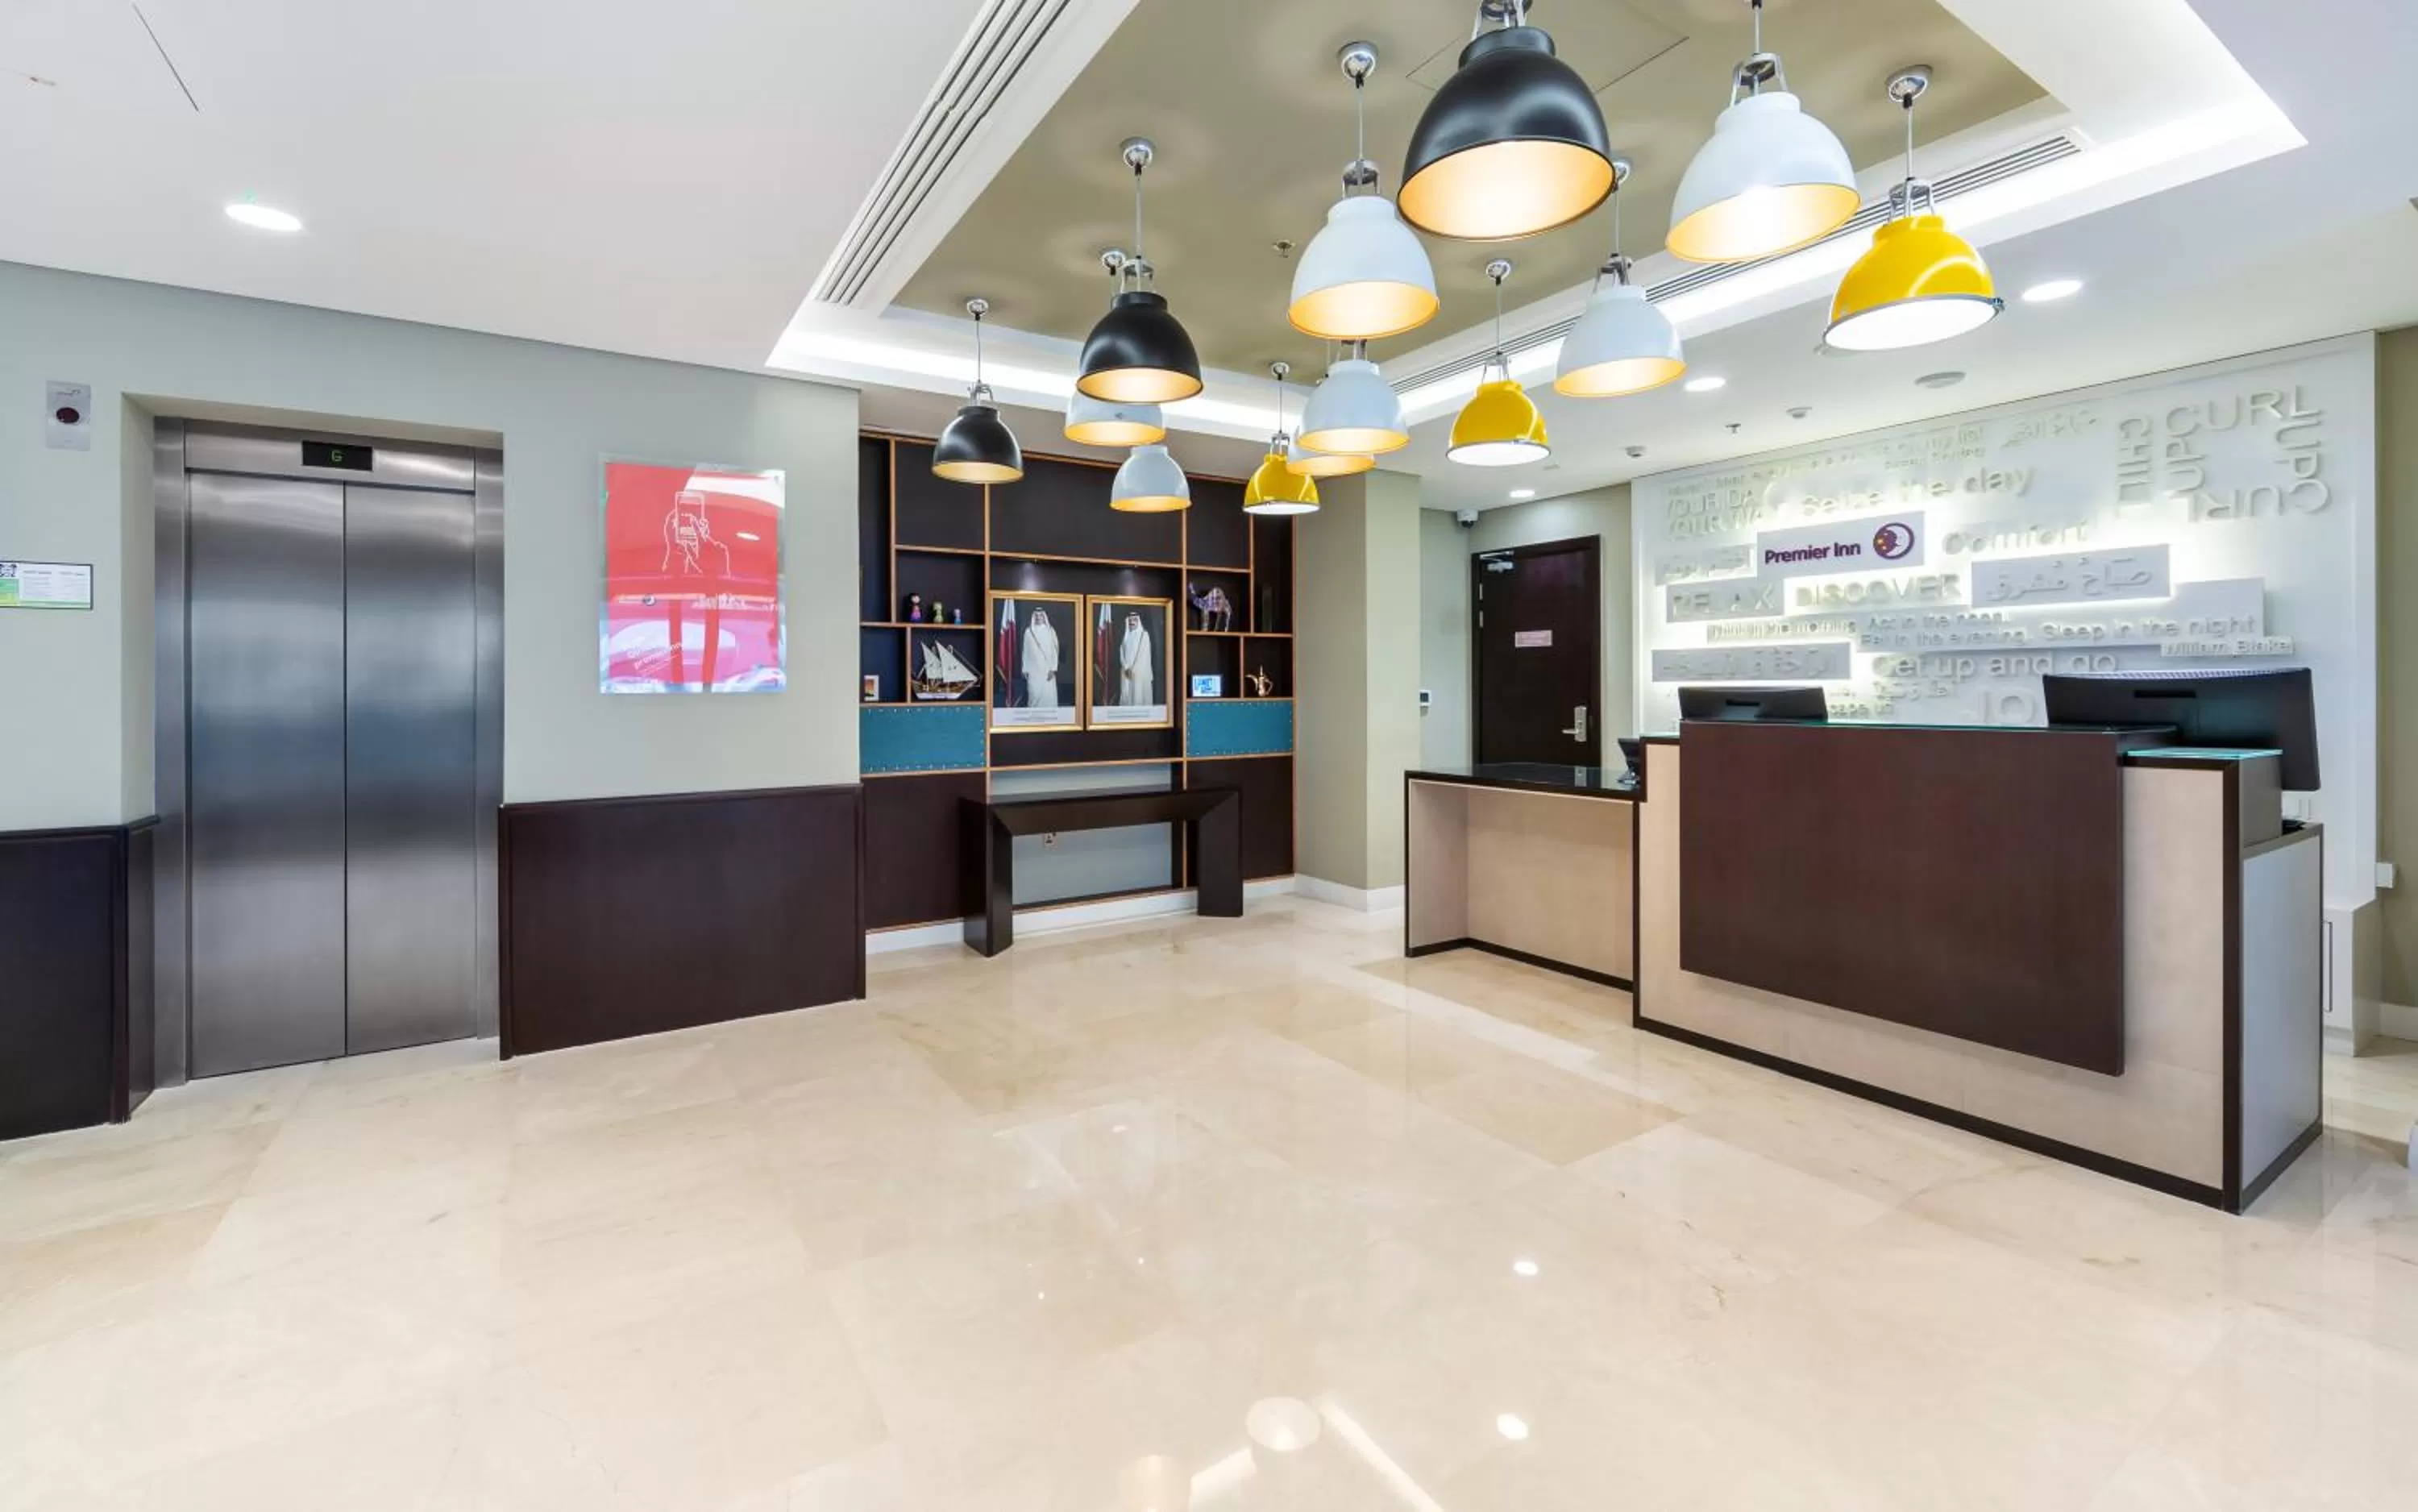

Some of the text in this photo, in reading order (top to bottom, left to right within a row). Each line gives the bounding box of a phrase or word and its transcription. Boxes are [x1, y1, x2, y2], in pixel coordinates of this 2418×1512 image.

[2166, 385, 2323, 438] CURL
[331, 449, 343, 462] G
[1963, 466, 2038, 498] day
[1764, 545, 1830, 564] Premier
[1834, 542, 1861, 557] Inn
[1942, 520, 2089, 555] Comfort
[1672, 581, 1776, 619] REAX
[1796, 573, 1962, 606] DISCOVER
[2040, 621, 2105, 642] Sleep
[2112, 620, 2133, 638] in
[2142, 614, 2180, 637] the
[2188, 614, 2256, 638] night
[1872, 652, 1926, 678] Get
[1935, 655, 1974, 683] up
[1988, 650, 2053, 675] and
